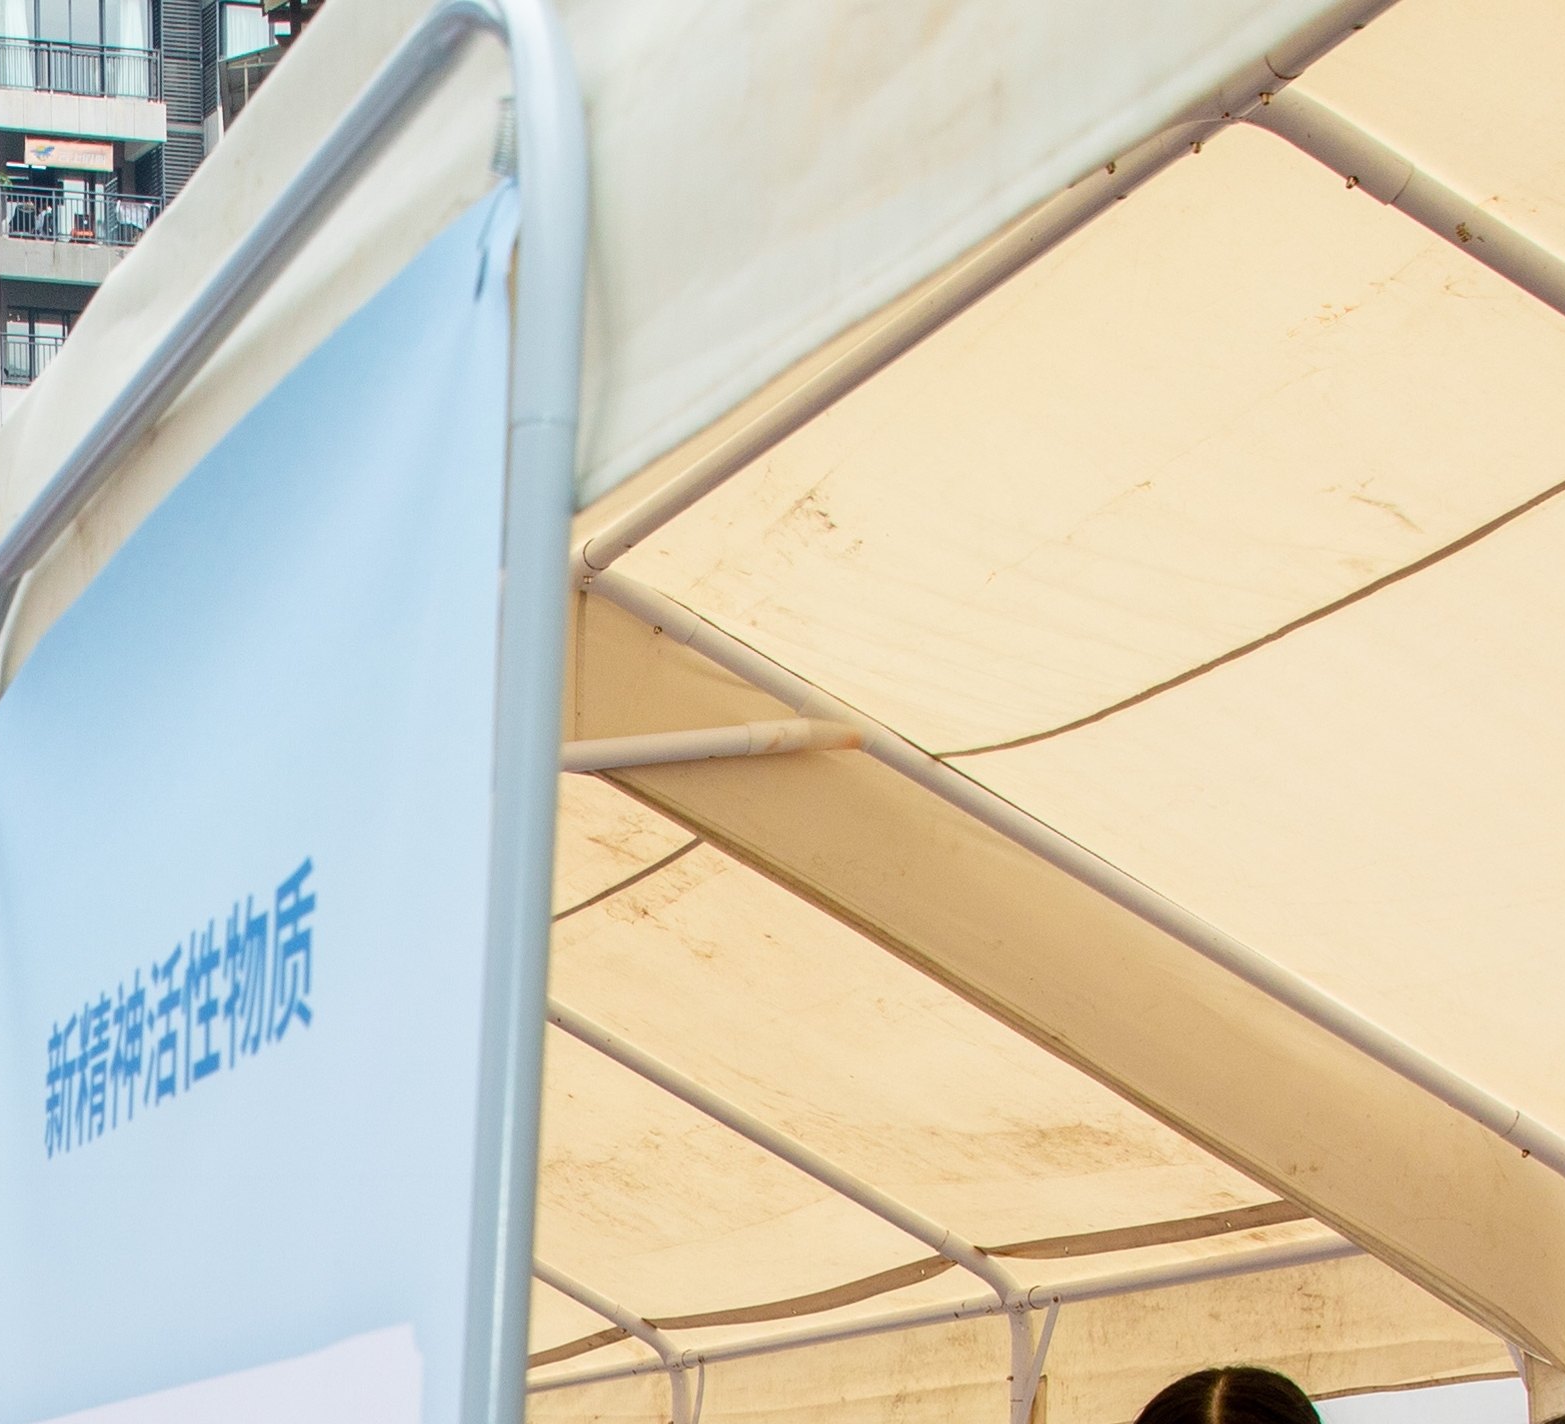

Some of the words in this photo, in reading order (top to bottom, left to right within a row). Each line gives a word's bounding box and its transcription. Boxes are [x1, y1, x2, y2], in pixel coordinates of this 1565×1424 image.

[46, 855, 318, 1160] 新精神活性物质
